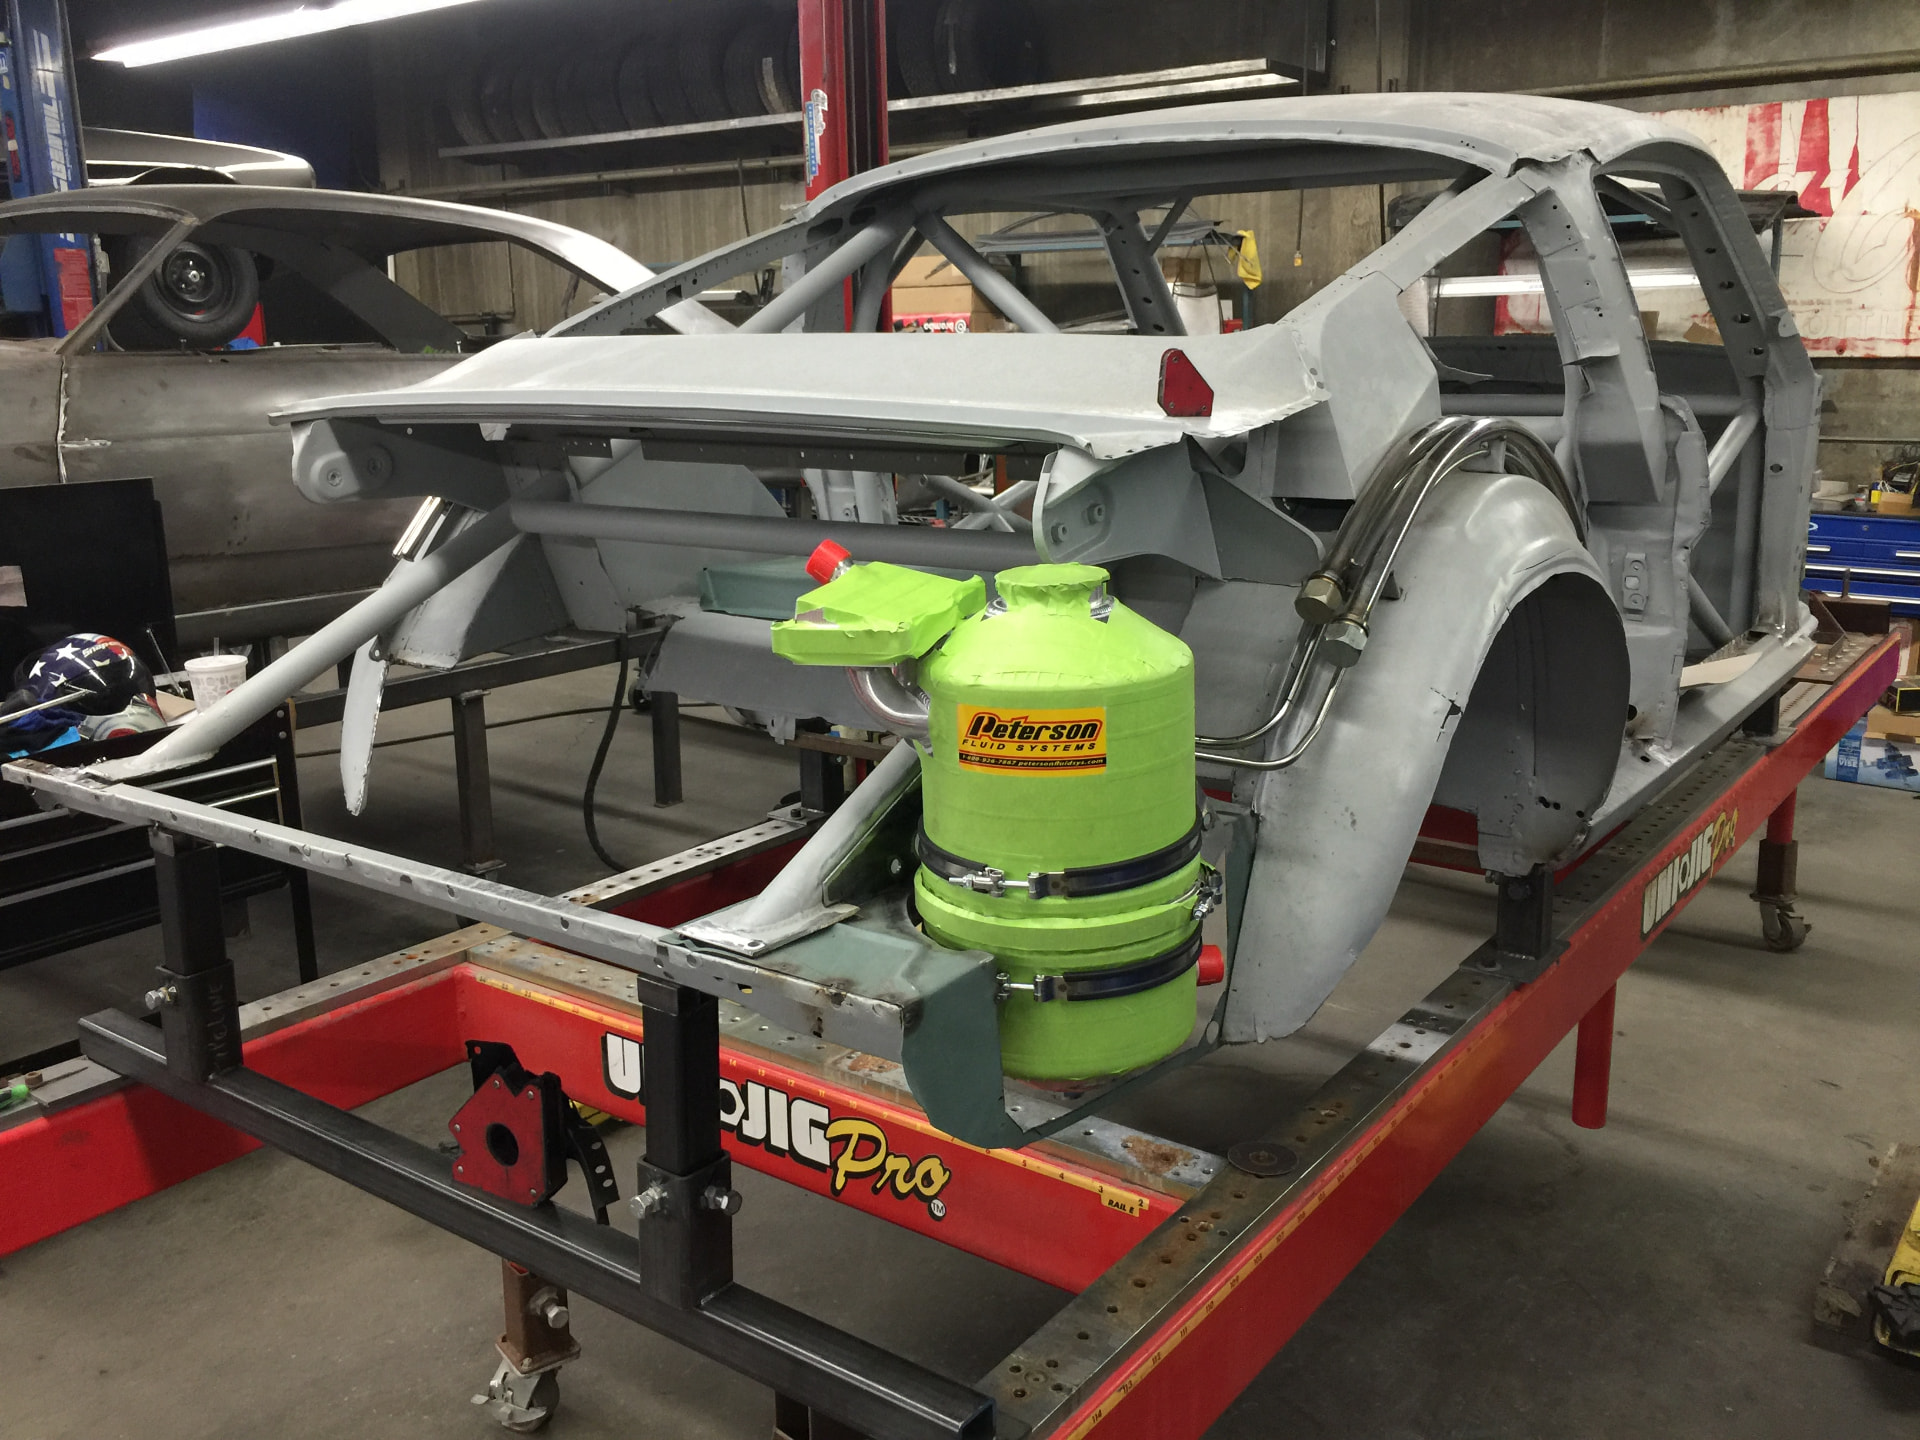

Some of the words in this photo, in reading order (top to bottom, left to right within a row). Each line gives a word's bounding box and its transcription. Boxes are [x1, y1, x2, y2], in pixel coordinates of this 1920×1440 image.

[968, 715, 1100, 741] Peterson
[962, 738, 1006, 750] FLUID
[1016, 742, 1096, 752] SYSTEMS
[1017, 757, 1104, 768] petersonfluidsys.com
[826, 1119, 950, 1197] Pro
[1098, 1185, 1104, 1194] 3
[1138, 1199, 1144, 1207] 2
[1108, 1199, 1127, 1212] RAIL
